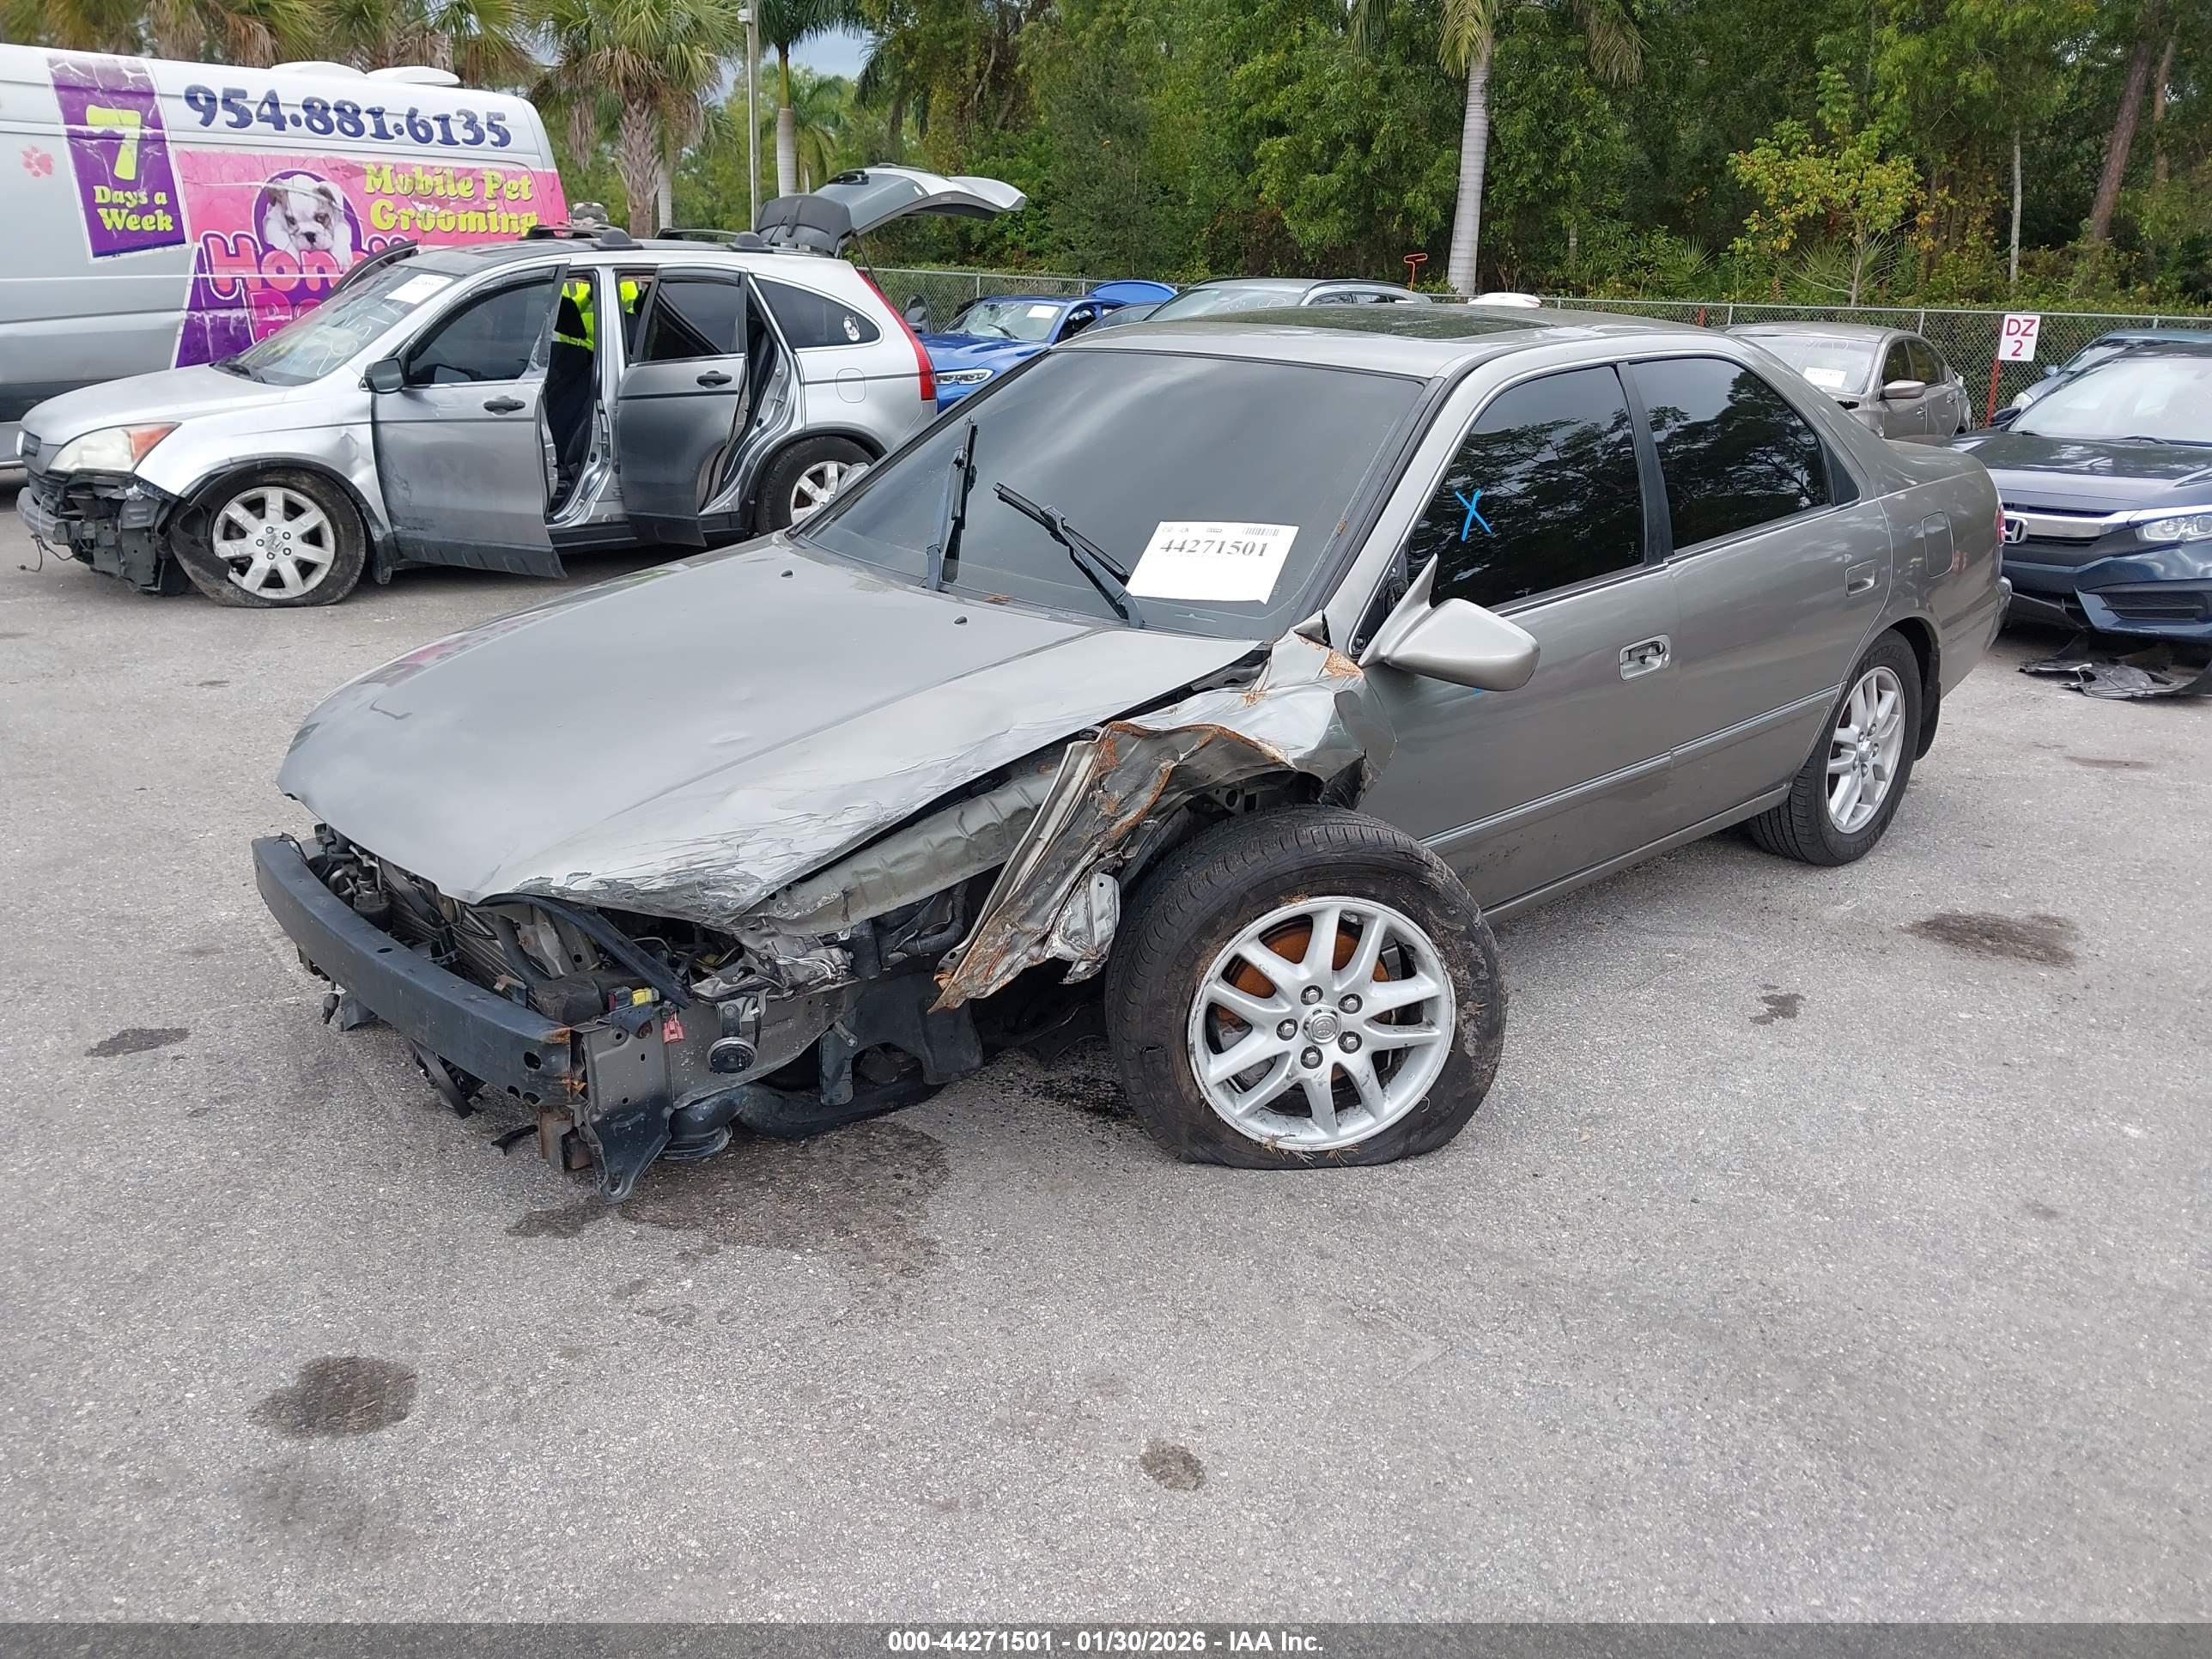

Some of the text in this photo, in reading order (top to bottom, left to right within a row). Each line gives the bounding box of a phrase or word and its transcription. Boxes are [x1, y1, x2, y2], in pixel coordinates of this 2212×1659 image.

[87, 104, 142, 181] 7
[363, 163, 533, 202] Mobile Pet
[94, 185, 168, 208] Days a
[97, 207, 174, 232] Week
[369, 198, 539, 238] Grooming
[2005, 318, 2037, 337] DZ
[2011, 339, 2023, 357] 2
[1160, 538, 1268, 557] 44271501
